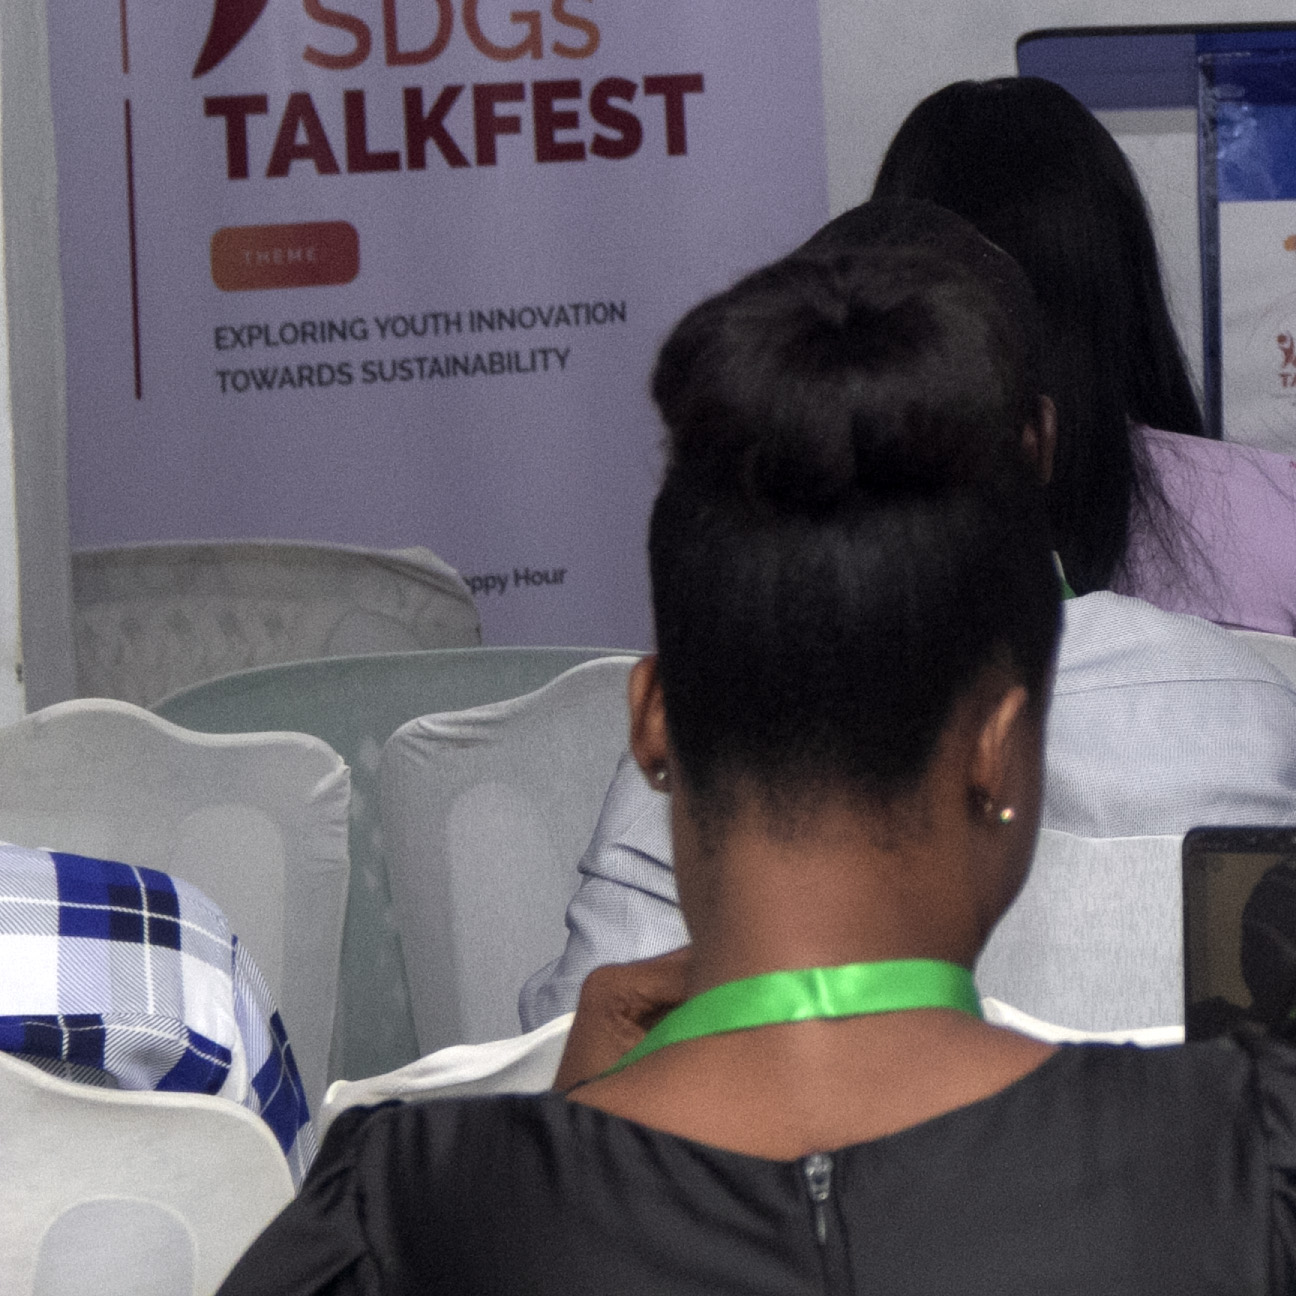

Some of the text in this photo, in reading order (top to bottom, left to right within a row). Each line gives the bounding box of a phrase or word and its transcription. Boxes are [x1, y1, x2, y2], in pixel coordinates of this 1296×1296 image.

[203, 73, 705, 180] TALKFEST
[243, 247, 318, 265] THEME
[214, 300, 628, 352] EXPLORING YOUTH INNOVATION
[215, 347, 571, 394] TOWARDS SUSTAINABILITY
[512, 566, 569, 588] Hour
